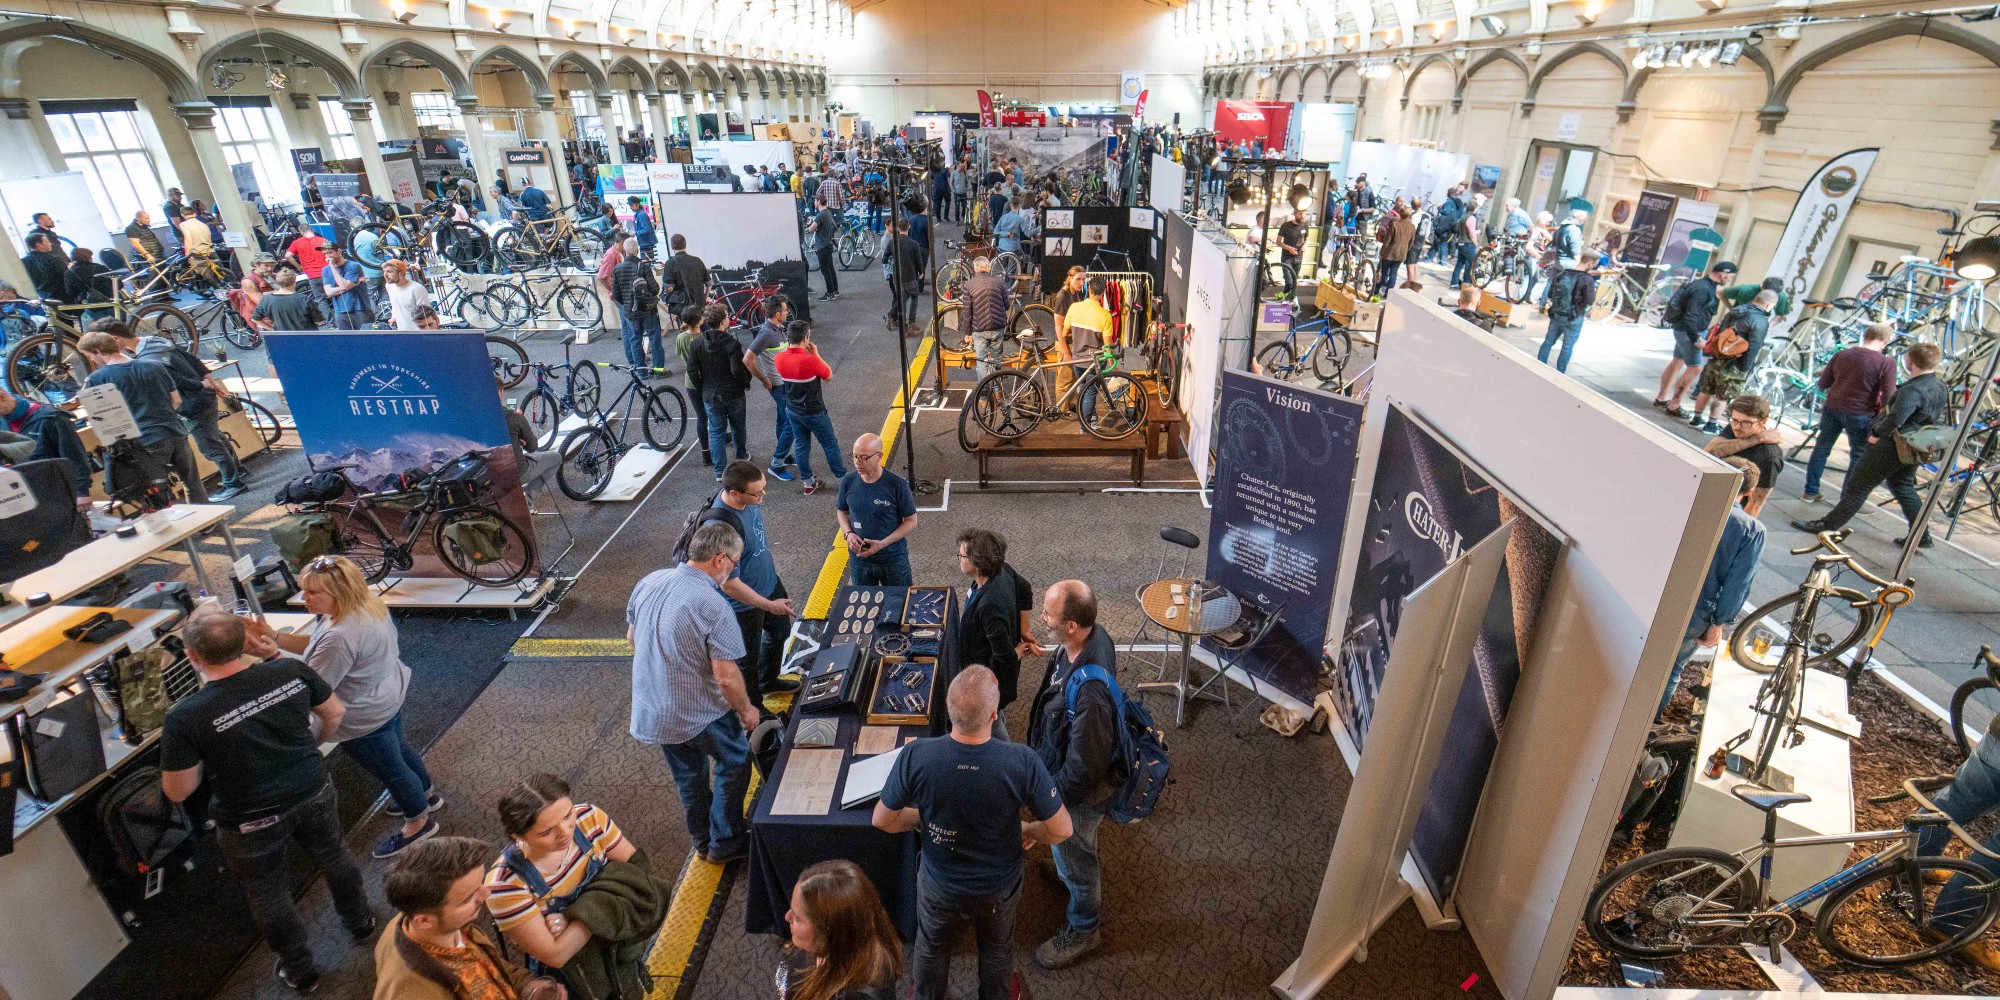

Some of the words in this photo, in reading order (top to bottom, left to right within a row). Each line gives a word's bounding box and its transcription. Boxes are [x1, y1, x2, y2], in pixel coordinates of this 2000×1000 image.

[349, 364, 376, 390] HANDMADE
[390, 364, 431, 390] YORKSHIRE
[349, 400, 440, 416] RESTRAP
[1266, 387, 1311, 414] Vision
[1238, 482, 1273, 498] established
[1274, 494, 1282, 502] in
[1284, 498, 1302, 510] 1890,
[1304, 504, 1316, 514] has
[1240, 472, 1280, 492] Chater-Lea,
[1282, 488, 1316, 504] originally
[1236, 492, 1264, 506] returned
[1266, 502, 1280, 512] with
[1288, 510, 1315, 524] mission
[1246, 504, 1268, 516] unique
[1278, 514, 1286, 524] its
[1288, 520, 1303, 530] very
[1253, 514, 1274, 529] British
[1276, 526, 1292, 536] soul.
[212, 708, 239, 726] COME
[258, 687, 282, 704] COME
[216, 716, 242, 733] COME
[242, 693, 288, 719] HAILSTONE
